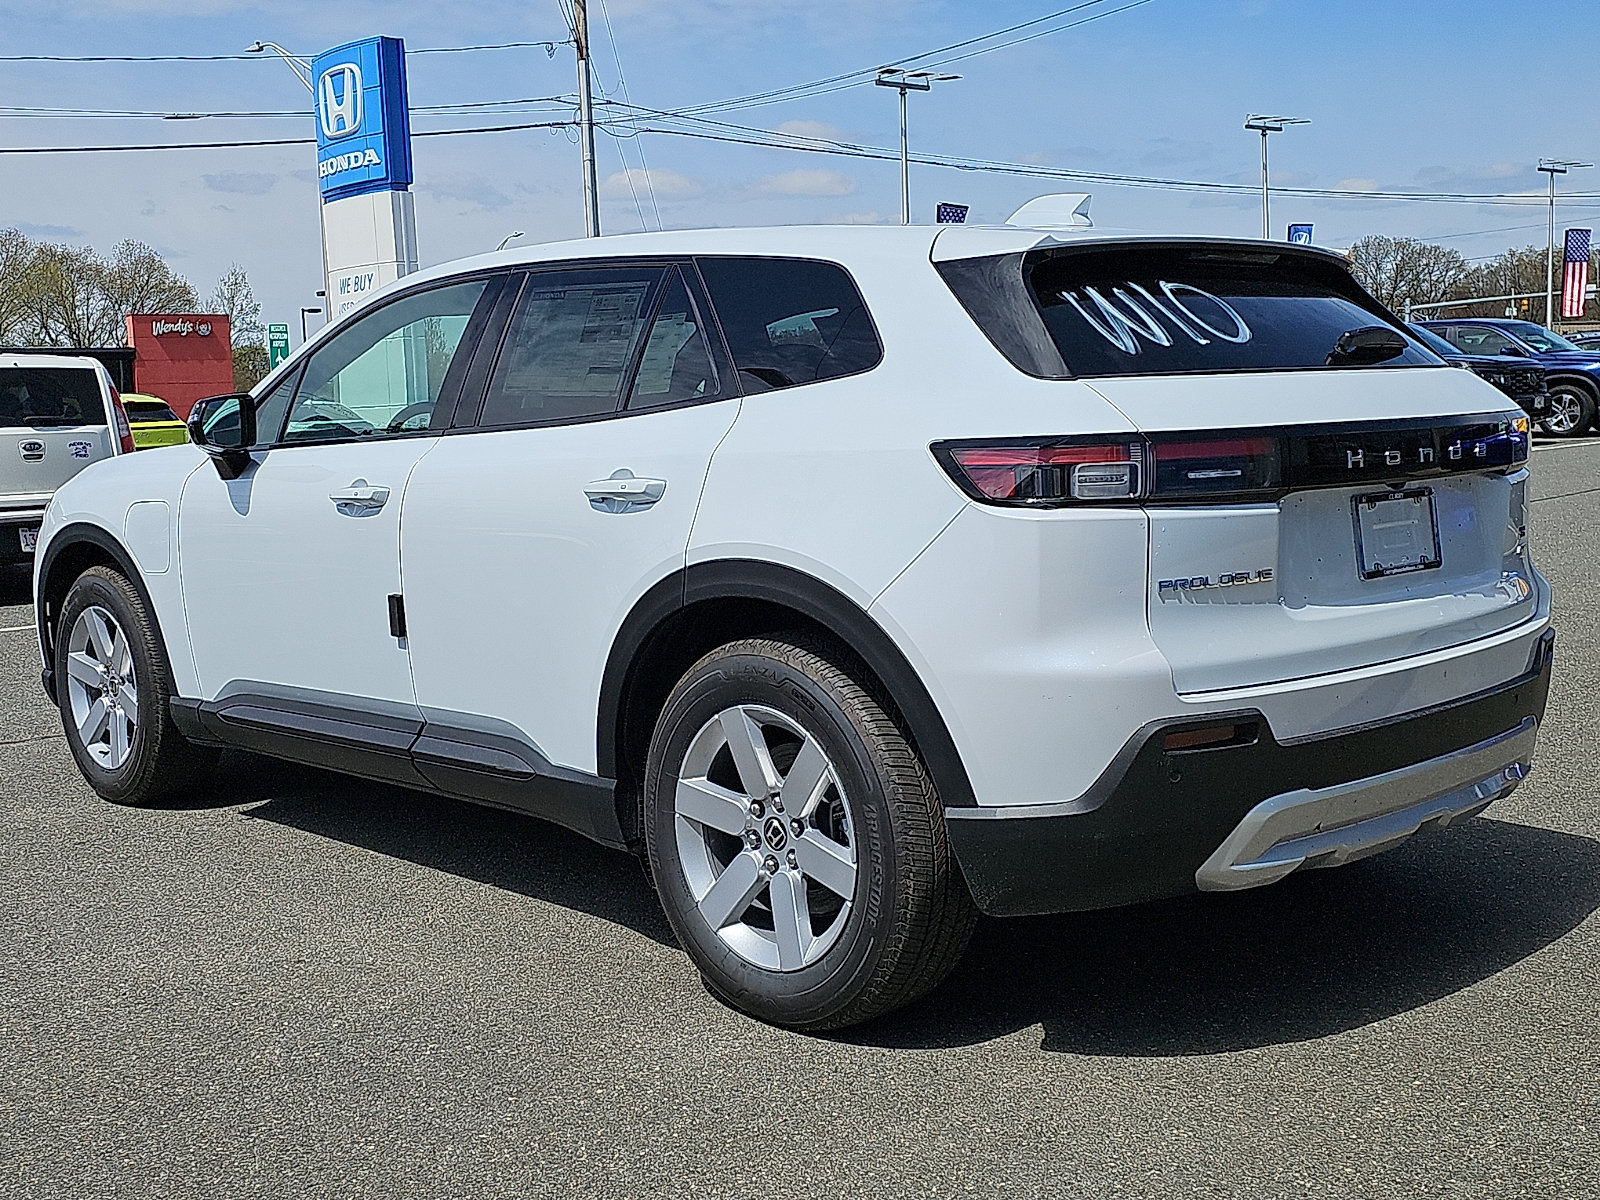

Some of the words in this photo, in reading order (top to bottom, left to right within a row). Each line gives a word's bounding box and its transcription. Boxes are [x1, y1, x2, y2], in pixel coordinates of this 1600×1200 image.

[319, 148, 381, 178] HONDA
[339, 277, 351, 295] WE
[354, 272, 374, 293] BUY
[152, 317, 194, 336] Wendy's
[1158, 567, 1273, 592] PROLOGUE
[862, 803, 884, 929] BRIDGESTONE
